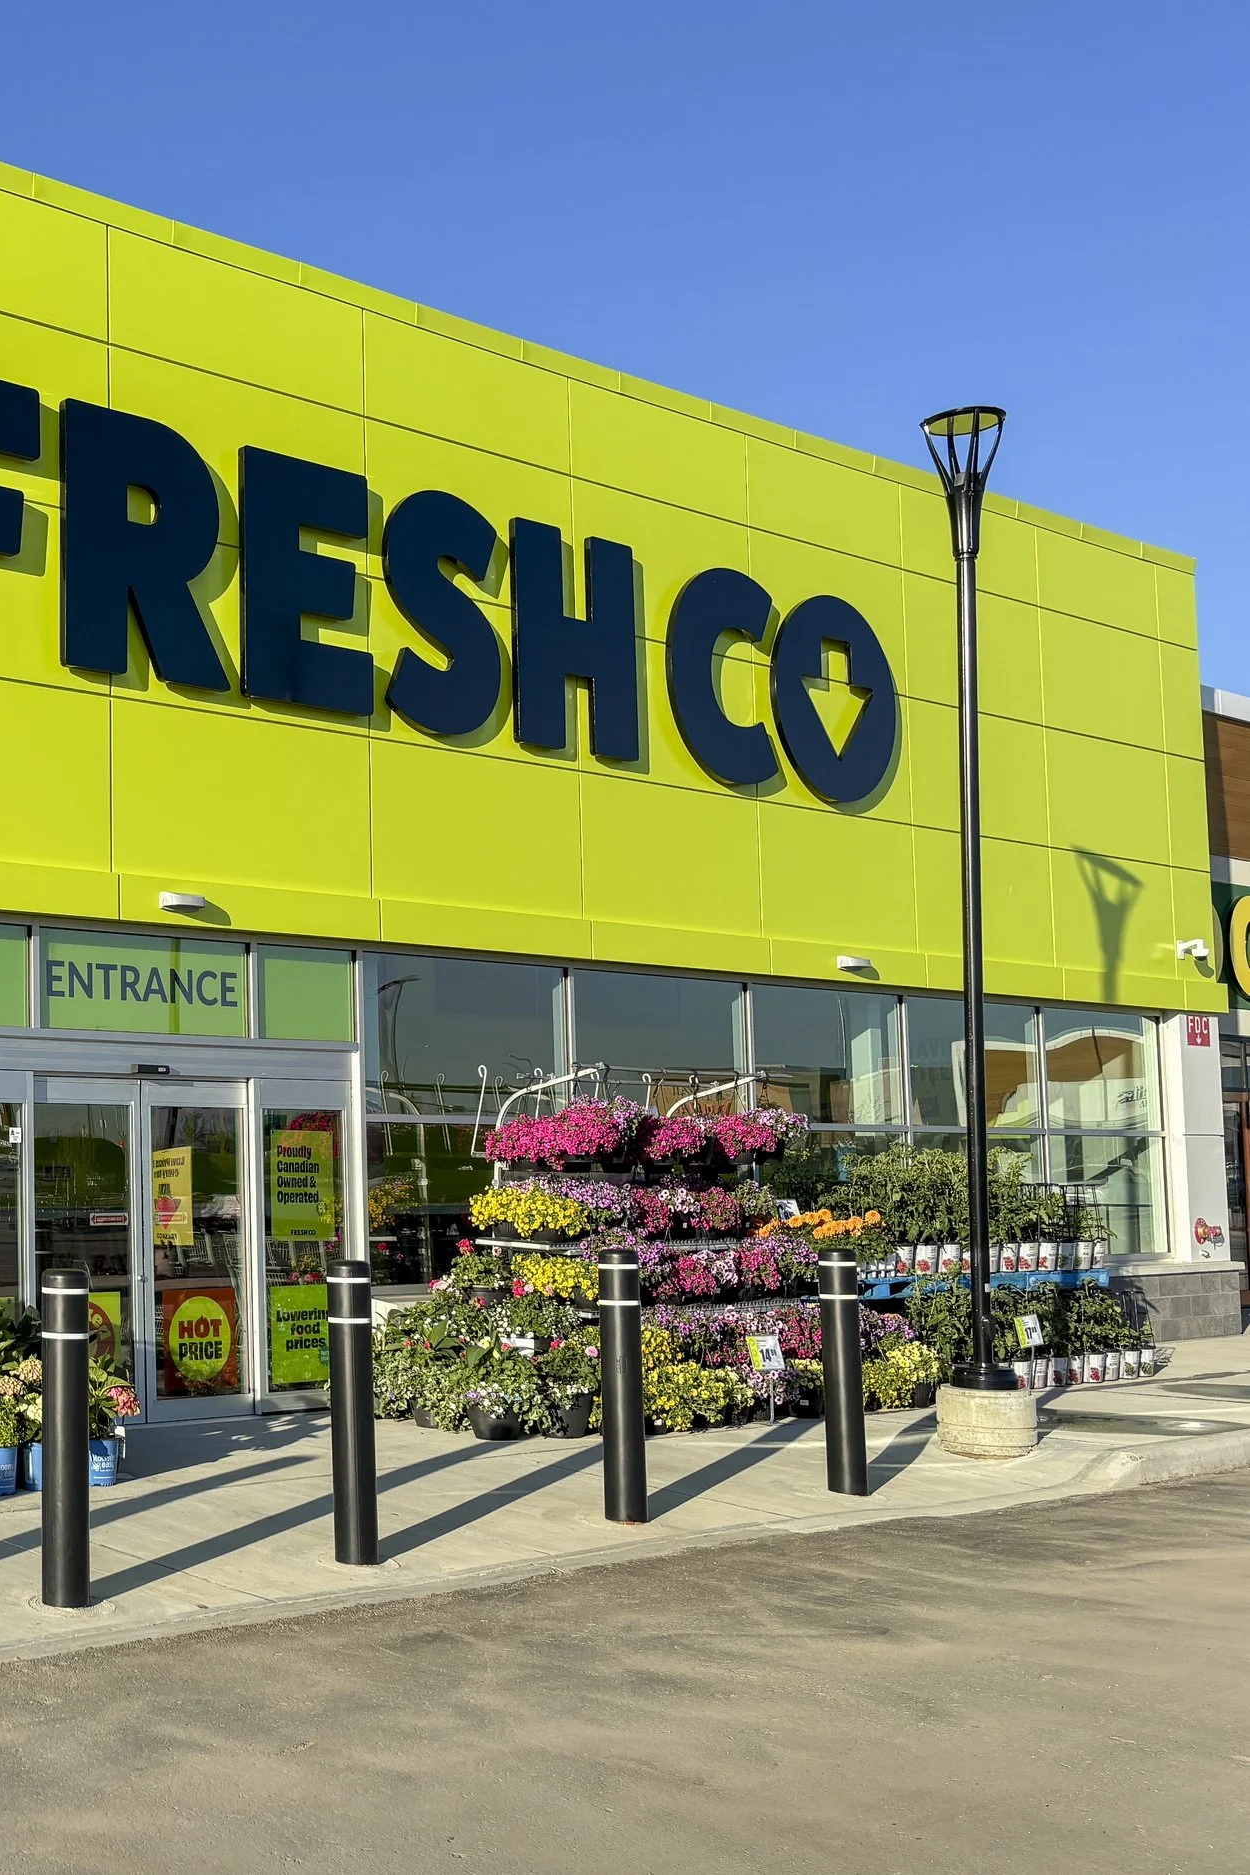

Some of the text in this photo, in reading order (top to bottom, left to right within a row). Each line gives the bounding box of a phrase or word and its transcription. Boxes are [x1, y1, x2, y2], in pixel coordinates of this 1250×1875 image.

[45, 959, 238, 1008] ENTRANCE
[1187, 1015, 1208, 1034] FDC
[277, 1145, 312, 1159] Proudly
[277, 1161, 319, 1173] Canadian
[277, 1176, 316, 1188] Owned &
[277, 1191, 319, 1204] Operated
[276, 1308, 328, 1322] Lowerin
[178, 1315, 222, 1339] HOT
[291, 1322, 320, 1335] food
[178, 1341, 222, 1361] PRICE
[286, 1337, 326, 1352] prices
